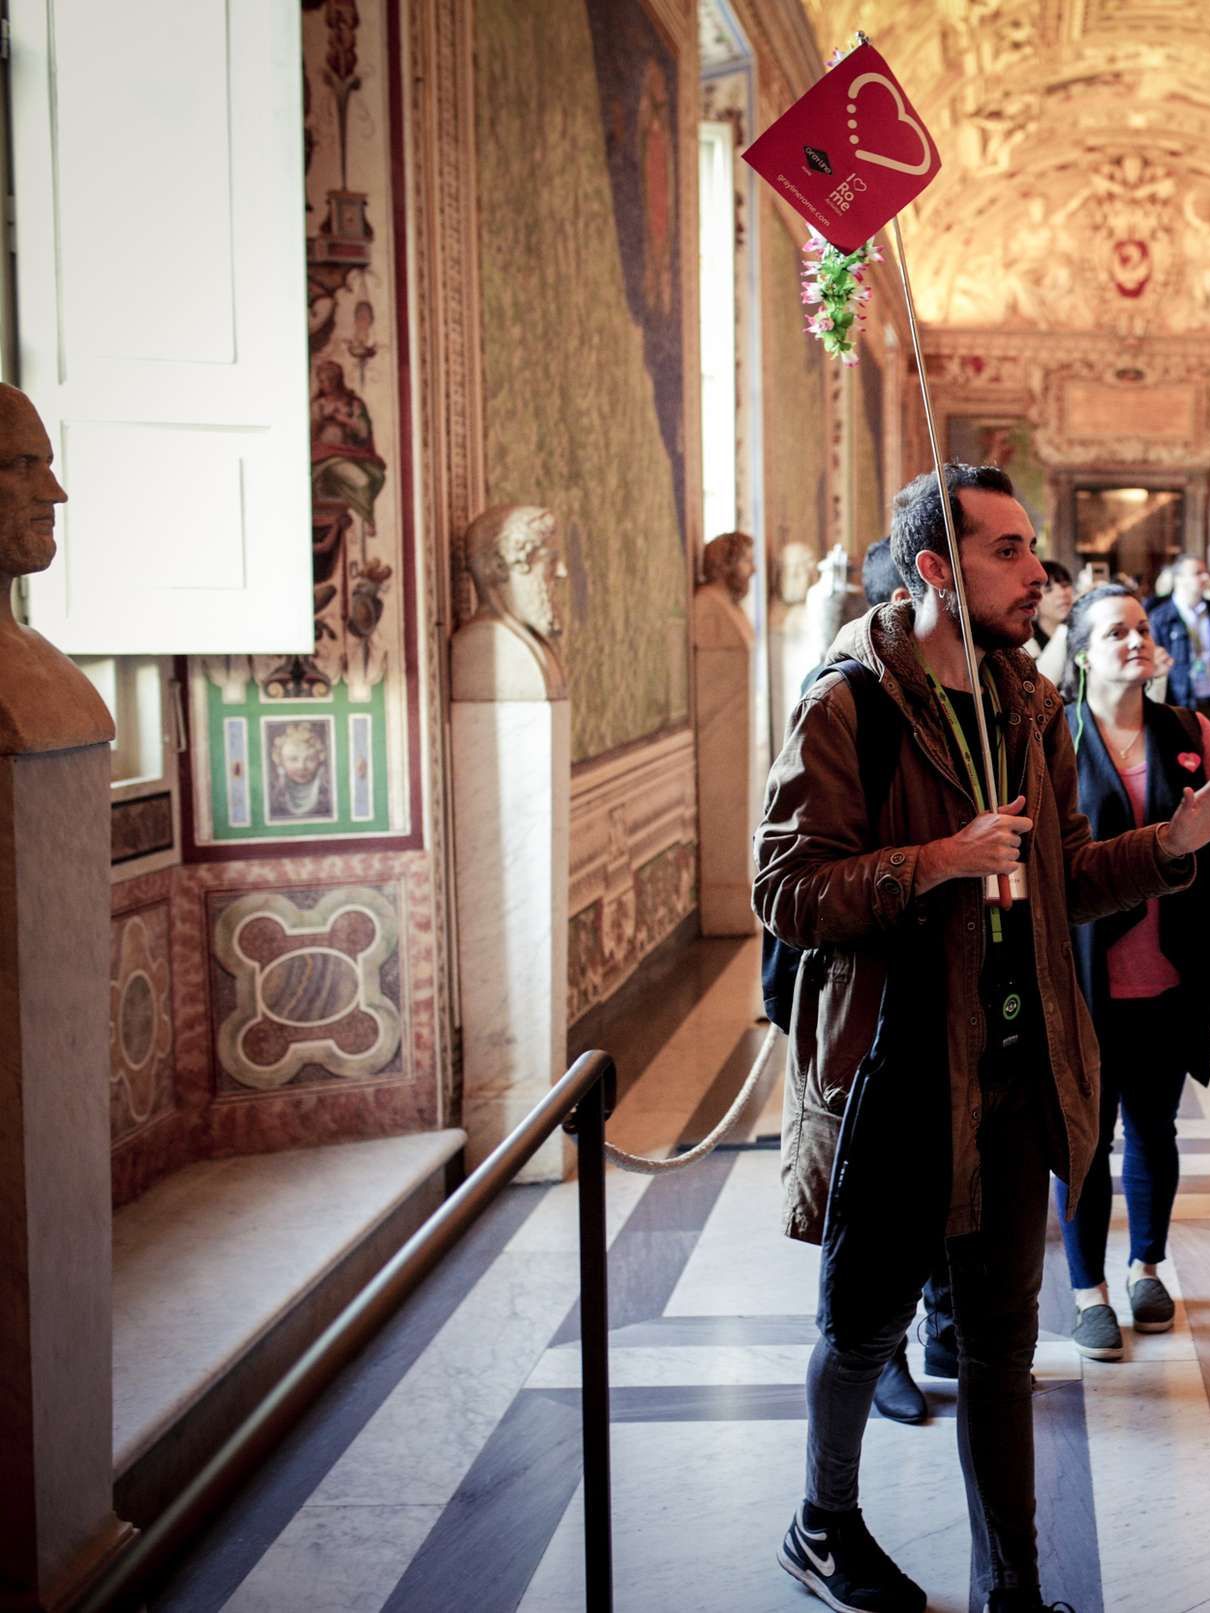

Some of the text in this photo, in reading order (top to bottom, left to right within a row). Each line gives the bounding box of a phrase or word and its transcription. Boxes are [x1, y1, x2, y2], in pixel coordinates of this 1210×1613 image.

[846, 173, 856, 182] I
[776, 174, 831, 227] graylinerome.com
[829, 190, 850, 212] me
[837, 182, 855, 202] Ro
